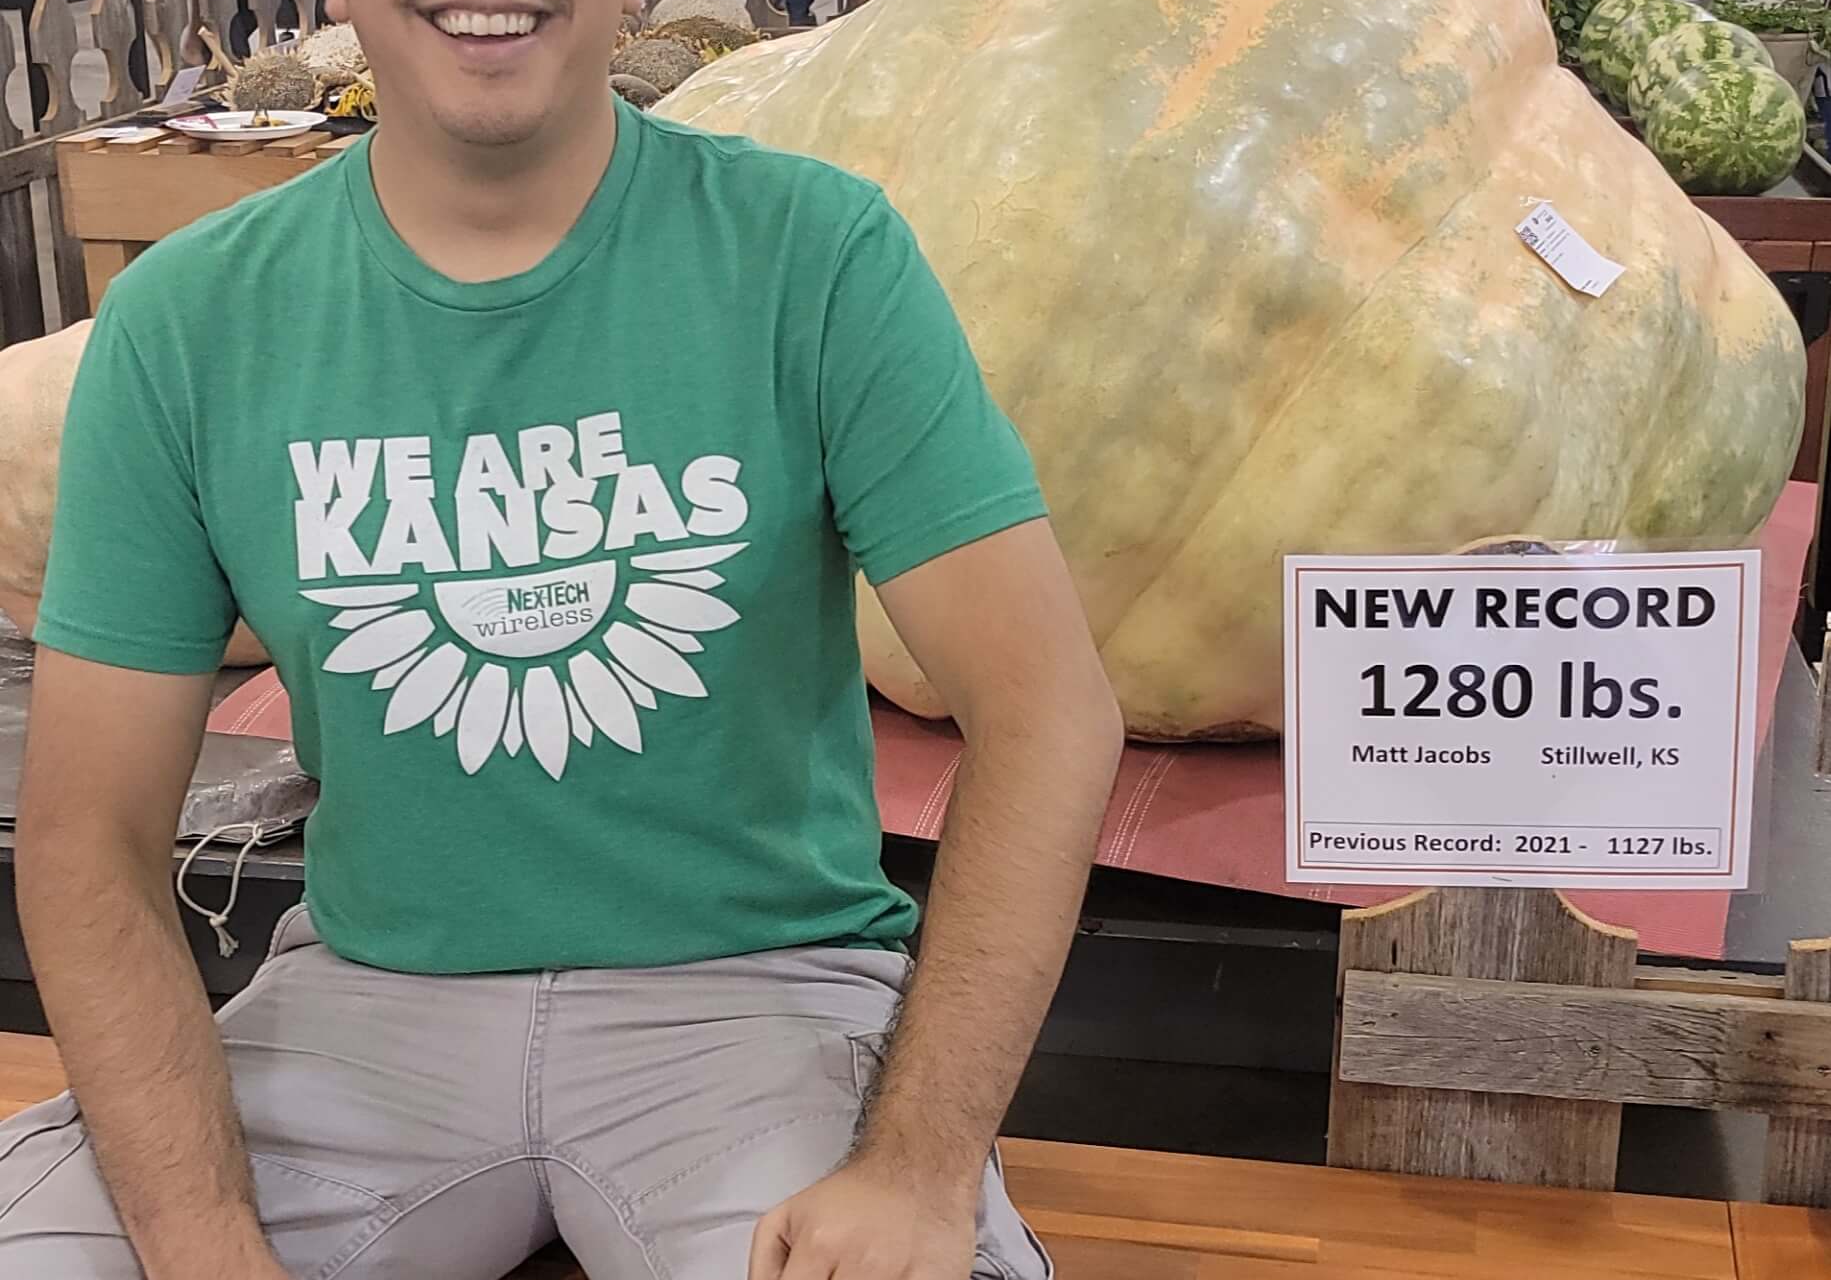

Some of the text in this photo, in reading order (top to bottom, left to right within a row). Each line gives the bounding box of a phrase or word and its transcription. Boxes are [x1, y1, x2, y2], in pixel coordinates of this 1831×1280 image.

[288, 411, 629, 502] WE ARE
[294, 455, 750, 581] KANSAS
[473, 607, 593, 638] wireless
[1314, 586, 1717, 630] NEW RECORD
[1360, 660, 1683, 719] 1280 lbs.
[1352, 745, 1680, 769] Matt Jacobs Stillwell, KS
[1310, 832, 1407, 851] Previous
[1413, 833, 1502, 853] Record:
[1515, 835, 1572, 854] 2021
[1608, 837, 1665, 855] 1127
[1672, 836, 1714, 855] lbs.
